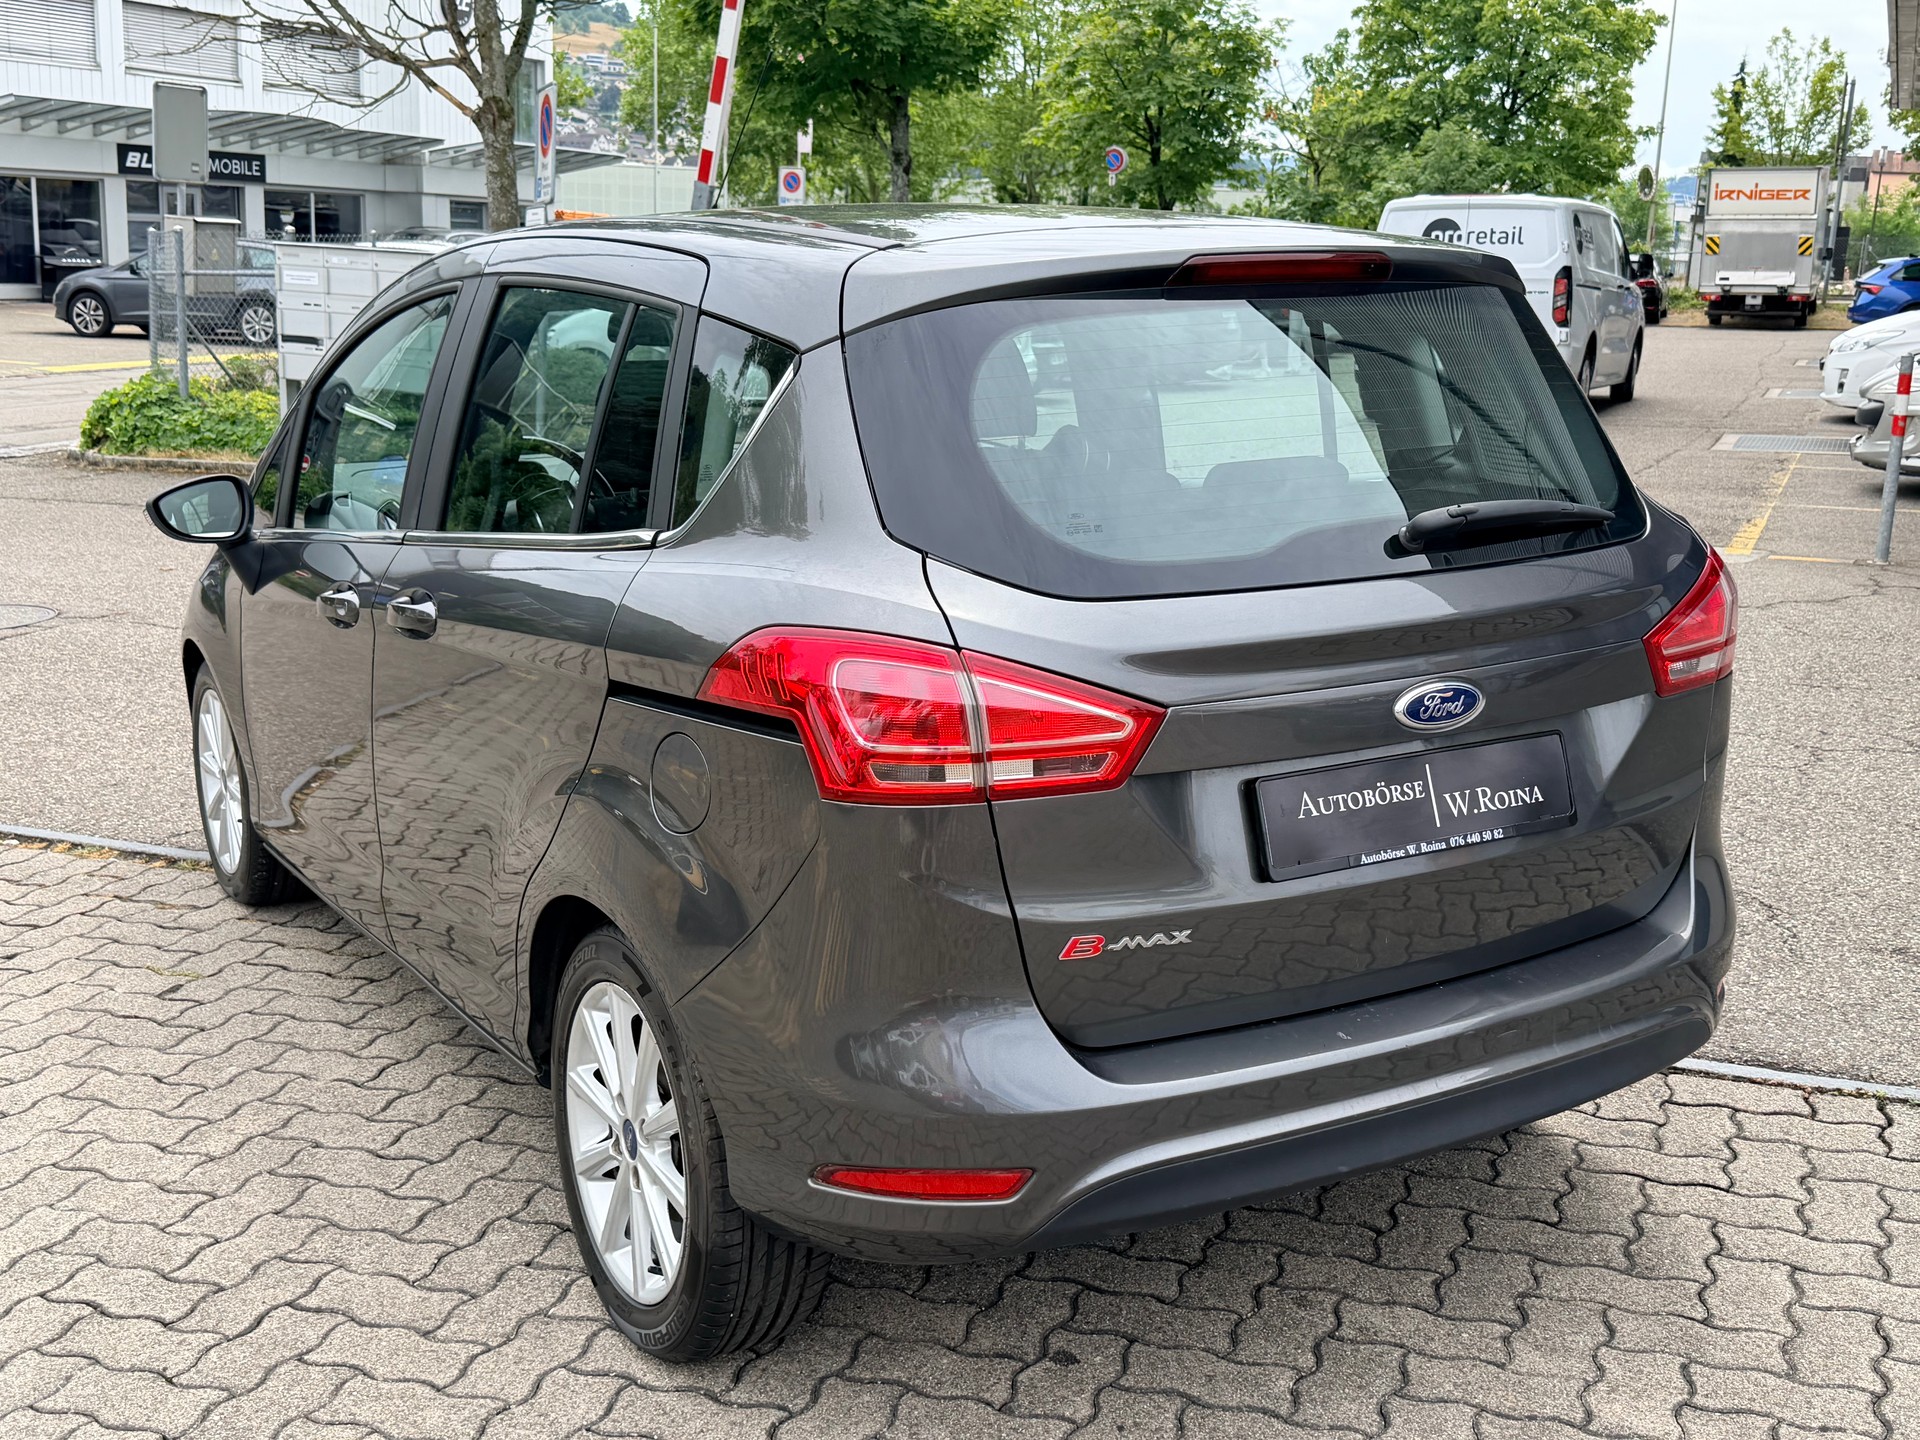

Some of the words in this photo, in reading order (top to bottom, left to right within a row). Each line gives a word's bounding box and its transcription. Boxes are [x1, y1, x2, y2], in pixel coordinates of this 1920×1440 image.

[208, 158, 262, 176] MOBILE
[1419, 691, 1466, 720] Ford
[1297, 780, 1426, 819] AUTOBÖRSE
[1360, 849, 1406, 865] Autobörse
[1406, 844, 1419, 856] W.
[1420, 841, 1447, 854] Roina
[1449, 834, 1465, 848] 076
[1466, 832, 1481, 844] 440
[1482, 829, 1492, 842] 50
[1493, 828, 1504, 839] 82
[1058, 928, 1193, 960] B-MAX
